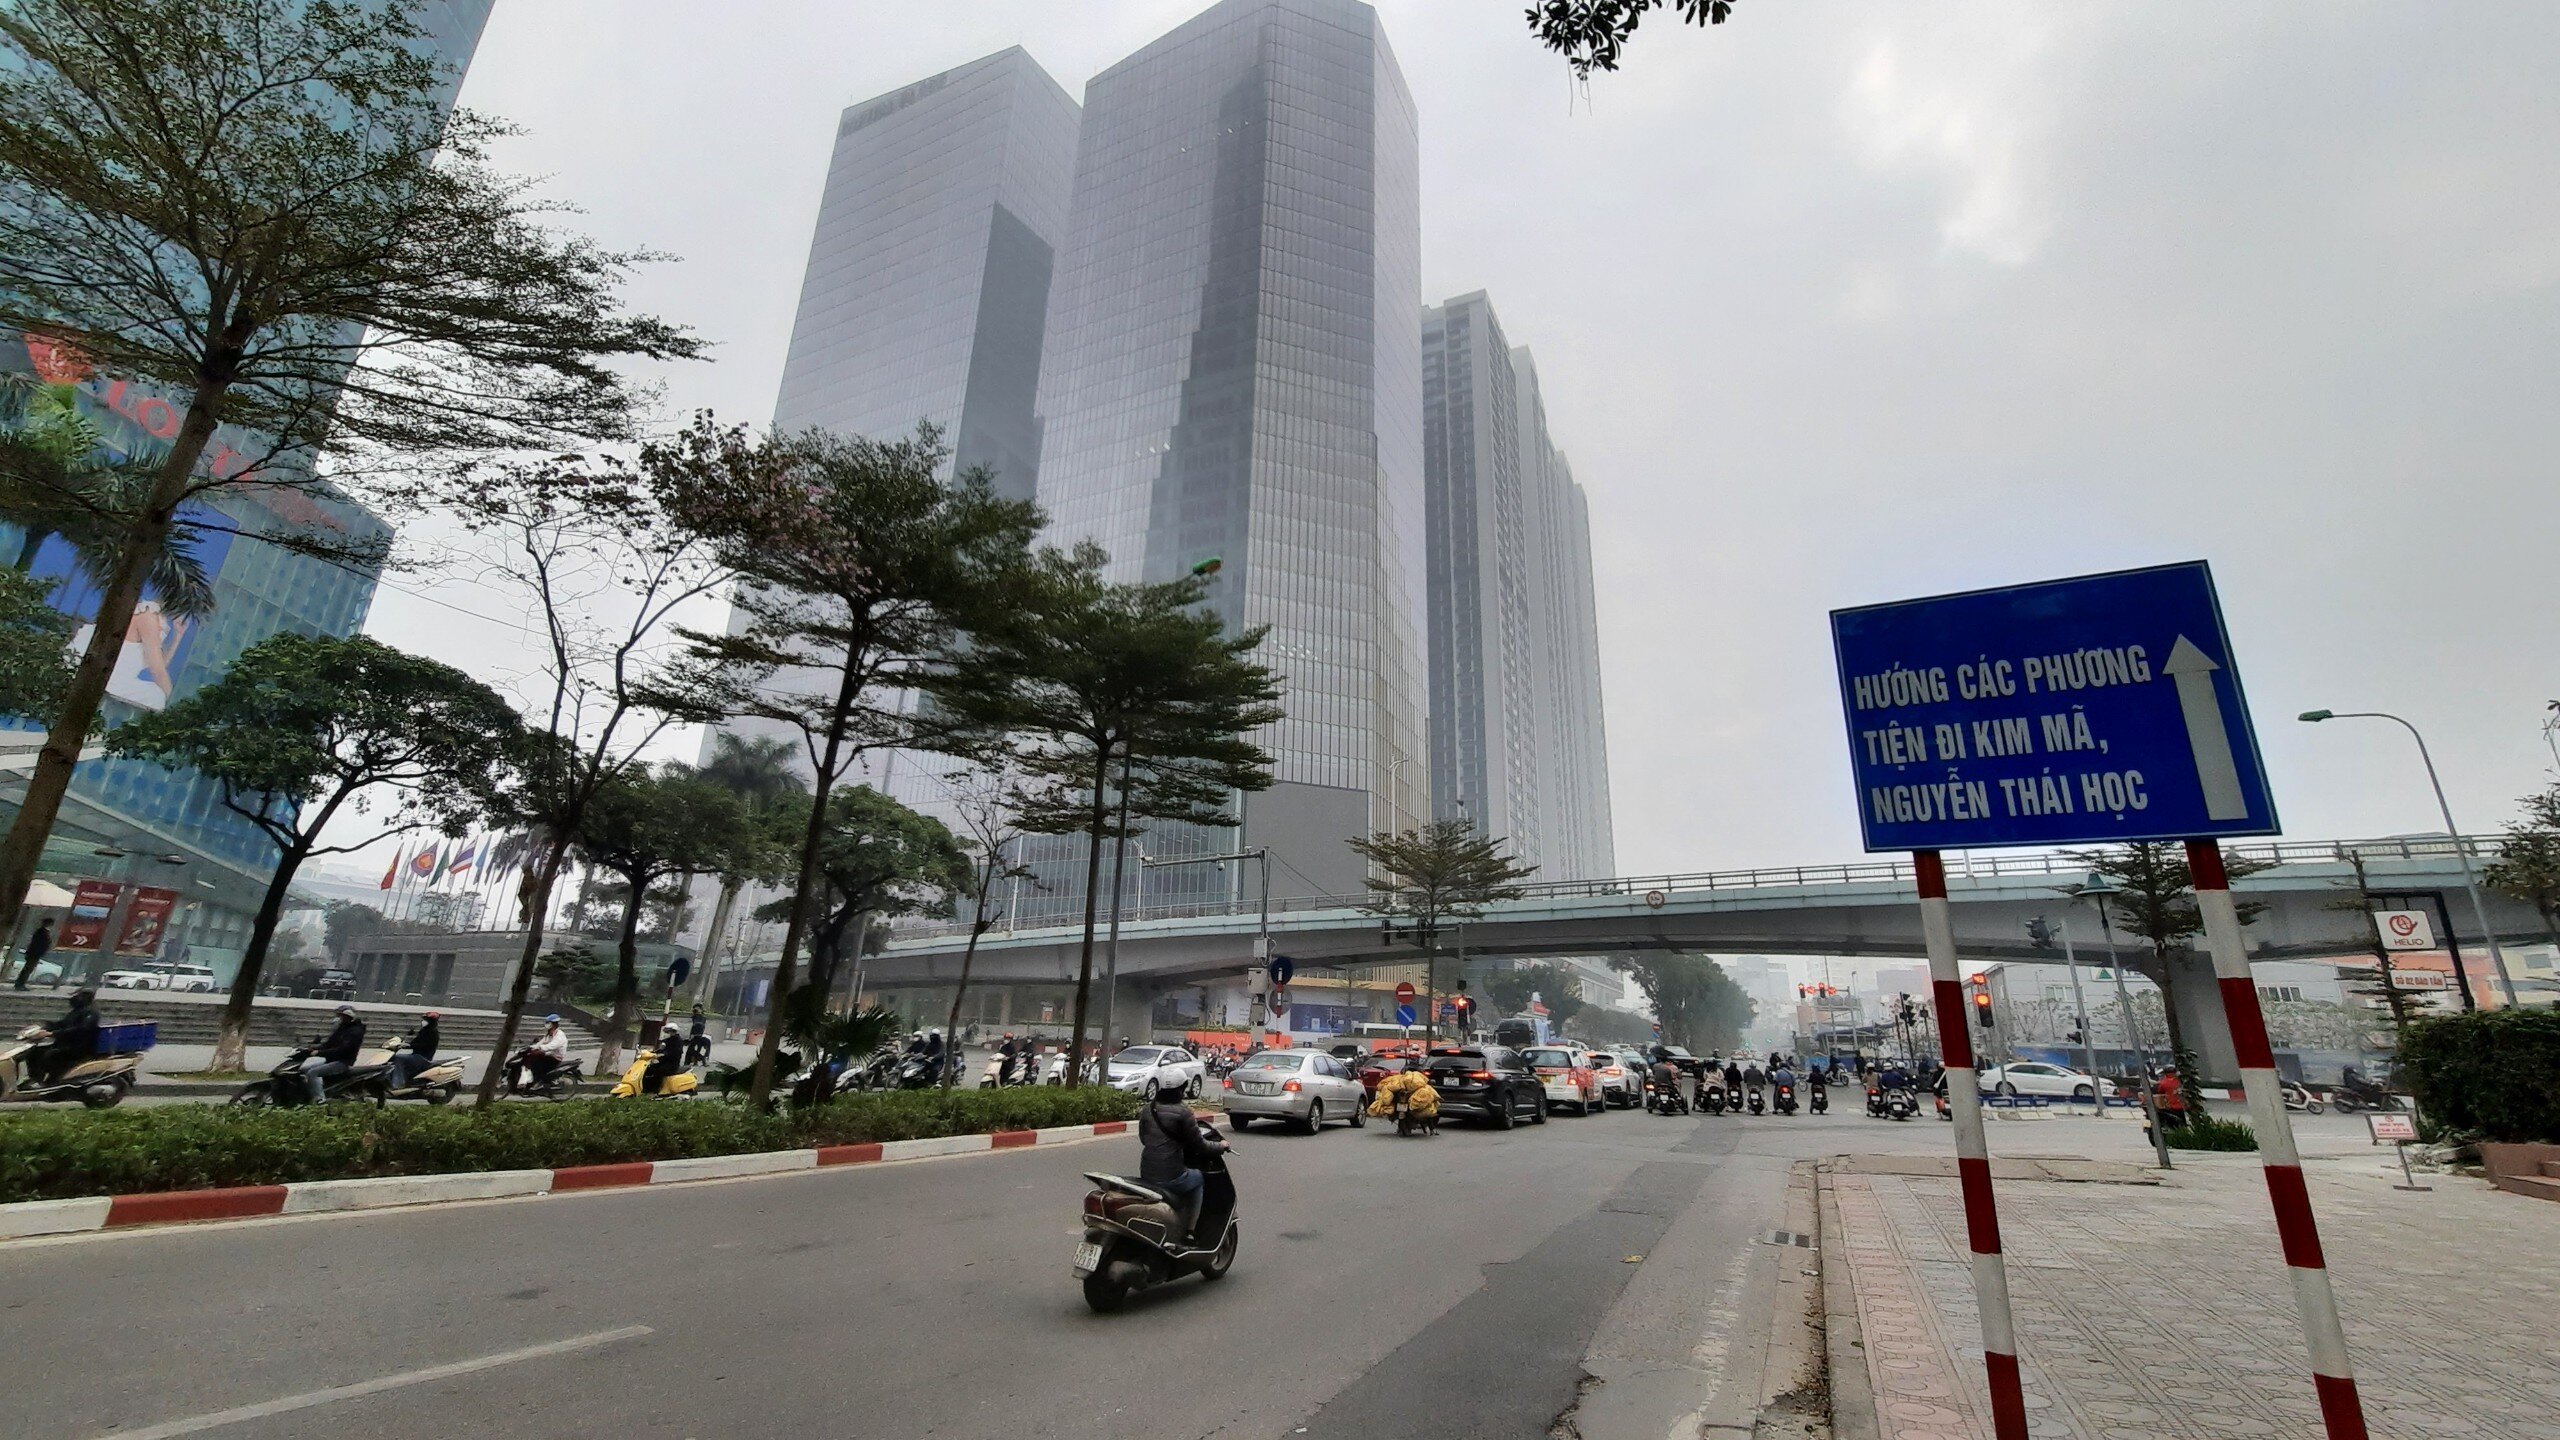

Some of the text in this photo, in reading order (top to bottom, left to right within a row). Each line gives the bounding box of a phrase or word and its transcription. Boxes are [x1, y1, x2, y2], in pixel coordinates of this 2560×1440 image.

[1854, 644, 2152, 710] HƯỚNG CÁC PHƯƠNG
[1863, 704, 2110, 772] TIỆN ĐI KIM MÃ,
[1871, 766, 2149, 824] NGUYỄN THÁI HỌC
